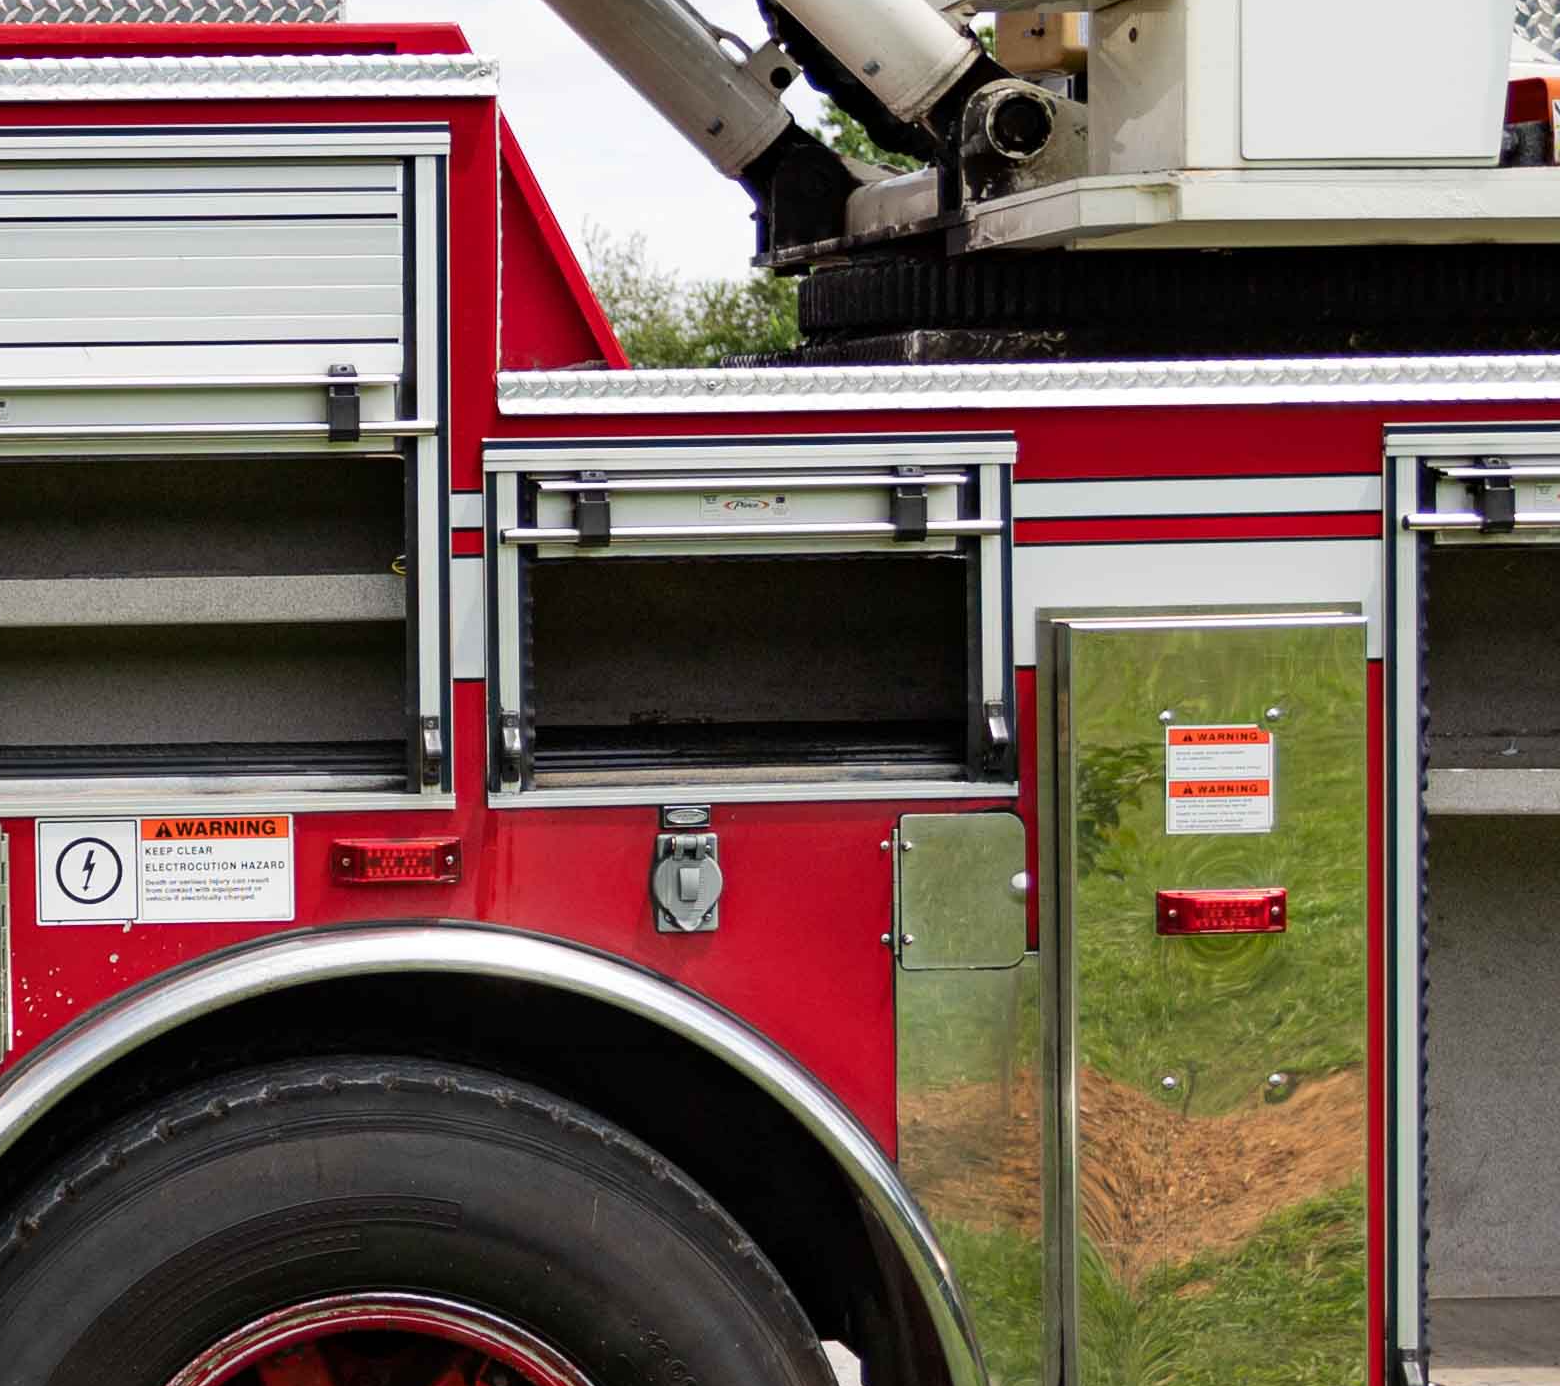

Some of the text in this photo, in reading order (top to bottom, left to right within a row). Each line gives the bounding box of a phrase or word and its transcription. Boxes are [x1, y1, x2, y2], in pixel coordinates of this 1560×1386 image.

[1198, 732, 1259, 742] WARNING
[1198, 784, 1259, 794] WARNING
[175, 819, 277, 836] WARNING
[145, 845, 213, 856] KEEP CLEAR
[145, 860, 286, 872] ELECTROCUTION HAZARD
